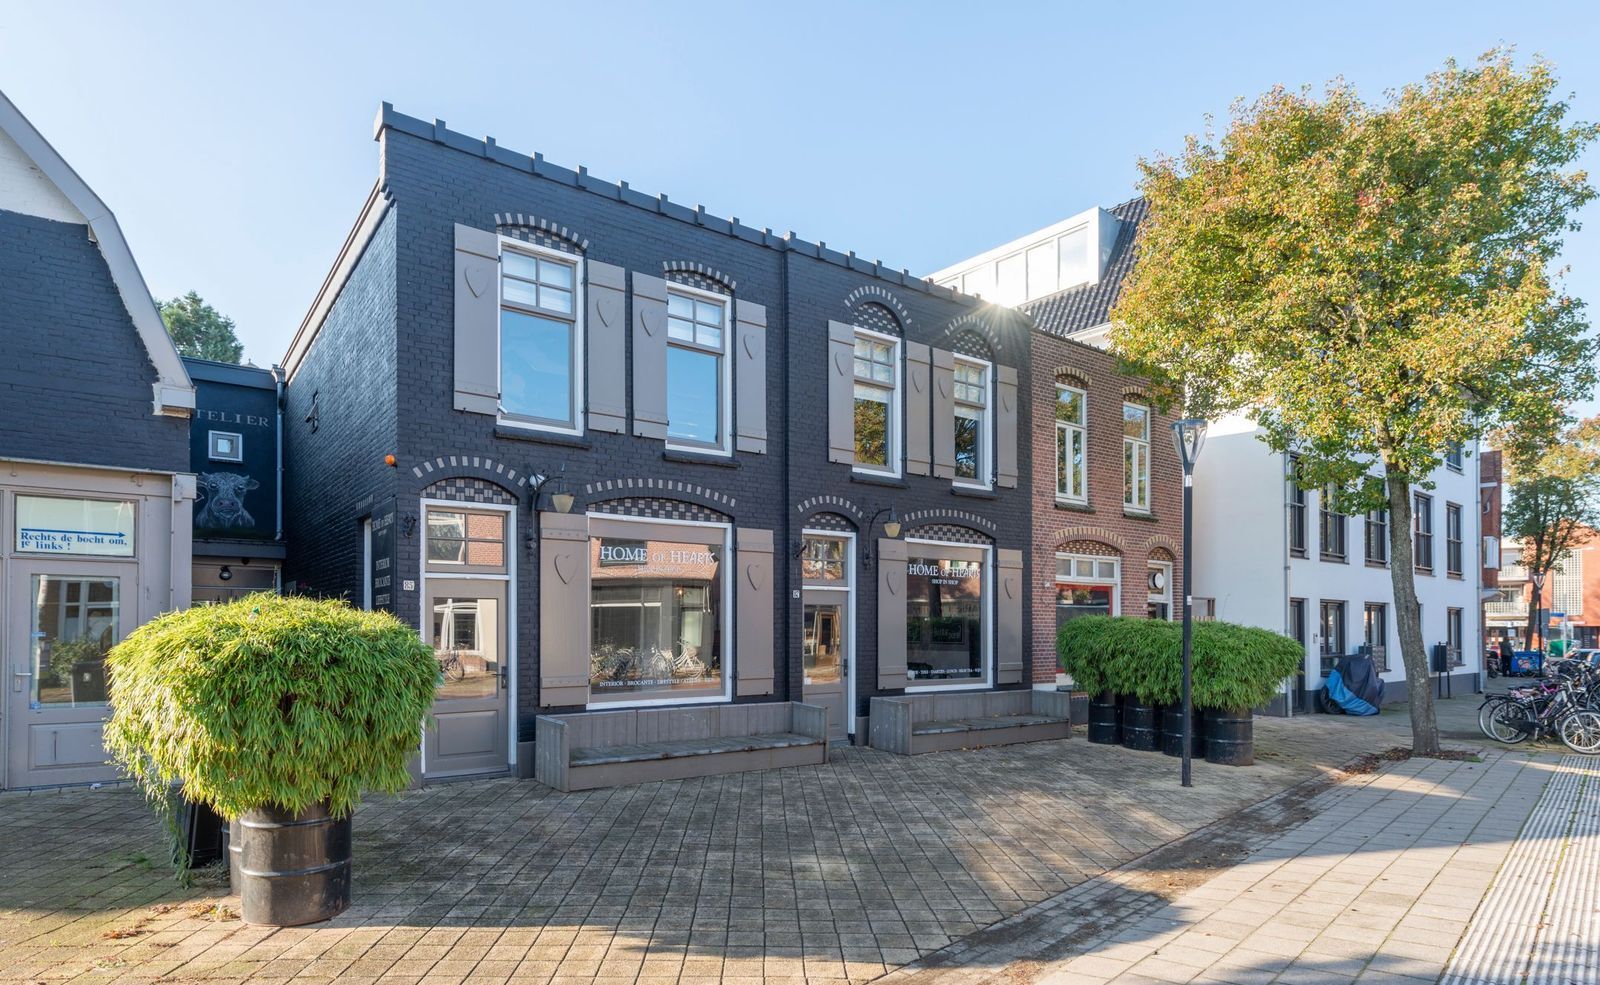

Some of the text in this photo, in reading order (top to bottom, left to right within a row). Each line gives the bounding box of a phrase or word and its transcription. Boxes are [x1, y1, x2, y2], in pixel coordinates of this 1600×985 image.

[197, 409, 269, 427] TELIER
[21, 532, 57, 541] Rechts
[60, 533, 73, 542] de
[76, 534, 104, 544] bocht
[35, 541, 63, 550] links
[600, 546, 648, 561] HOME
[908, 563, 939, 576] HOME
